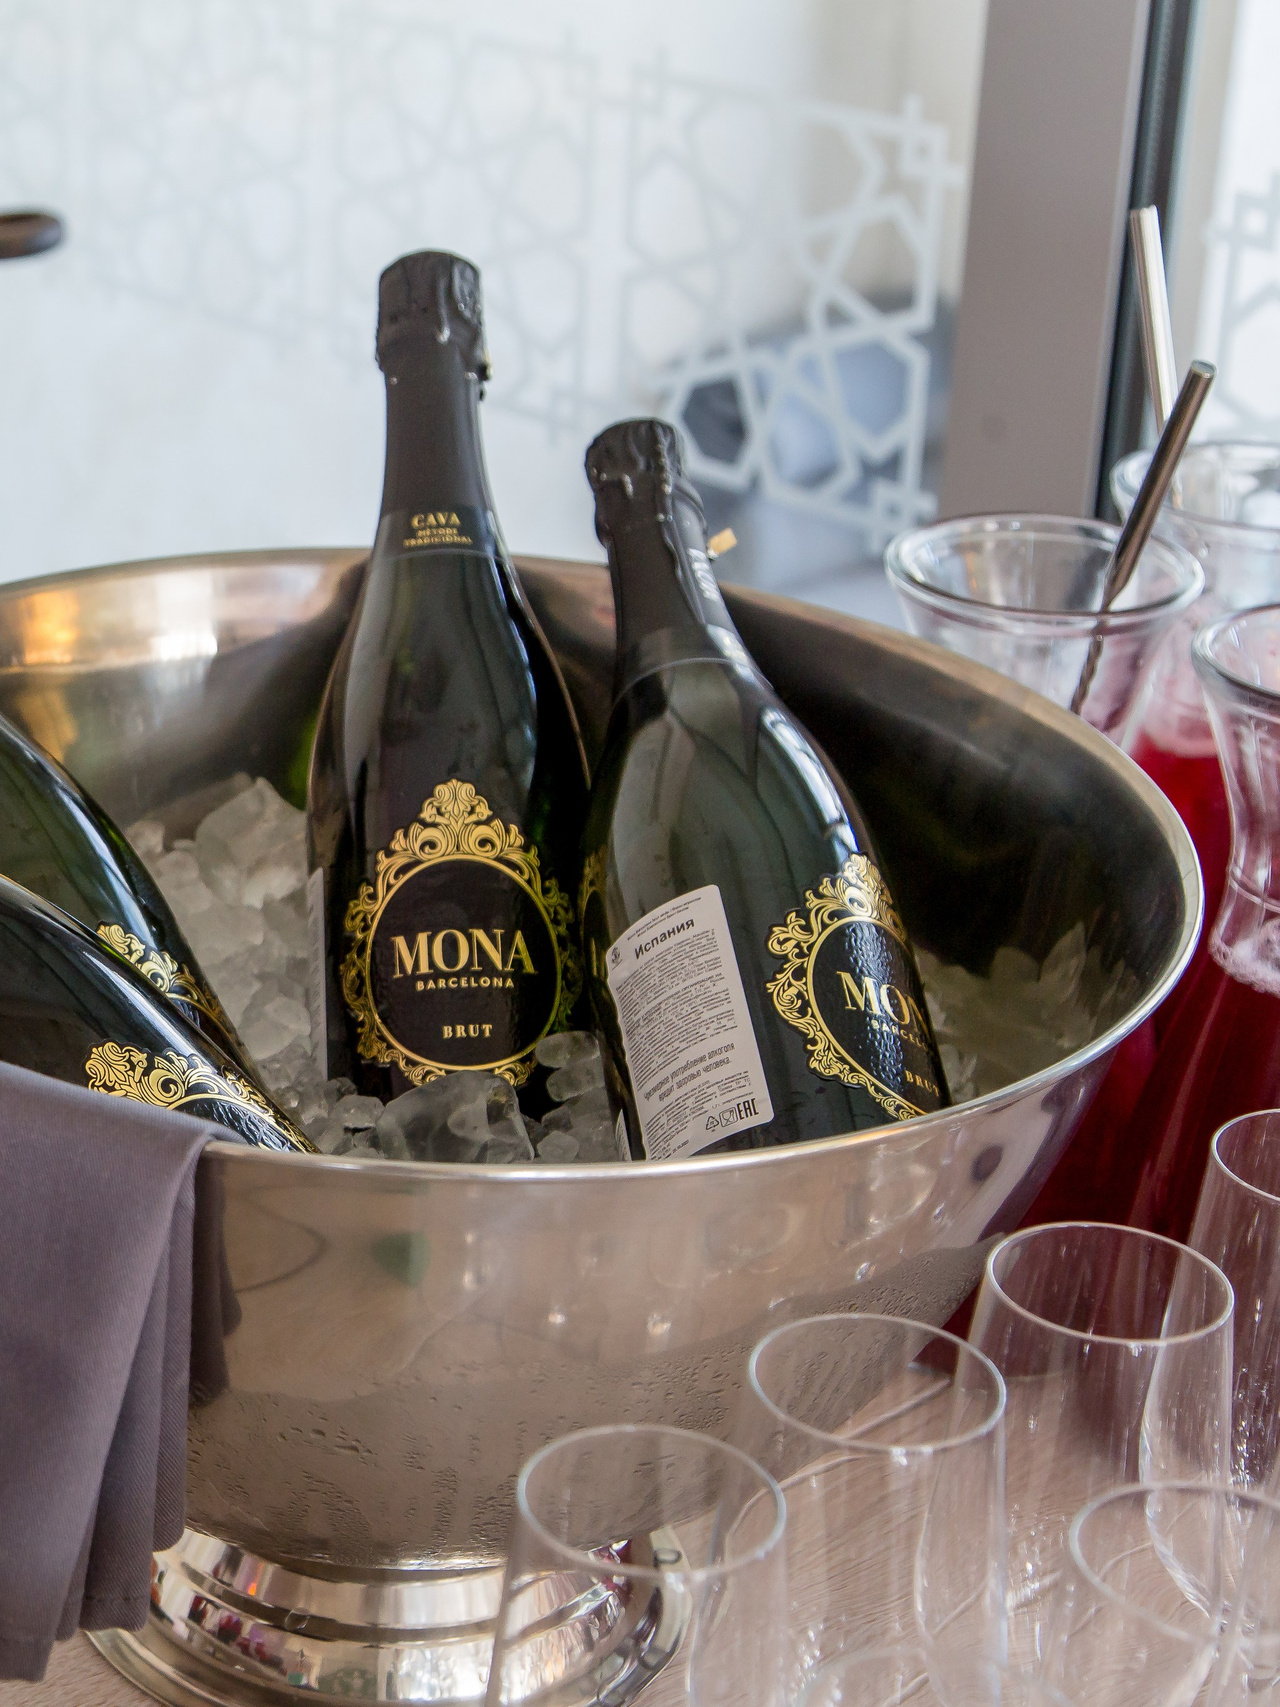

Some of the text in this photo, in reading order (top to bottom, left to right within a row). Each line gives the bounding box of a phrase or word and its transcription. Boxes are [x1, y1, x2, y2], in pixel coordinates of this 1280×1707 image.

[411, 512, 461, 529] CAVA
[634, 917, 696, 960] Испания
[390, 928, 538, 978] MONA
[416, 976, 515, 992] BARCELONA
[836, 971, 931, 1039] MON
[442, 1023, 494, 1040] BRUT
[670, 1053, 707, 1086] употребление
[706, 1042, 736, 1062] алкоголя
[702, 1058, 733, 1074] человека.
[905, 1070, 940, 1097] BRUT
[738, 1098, 760, 1120] EAC
